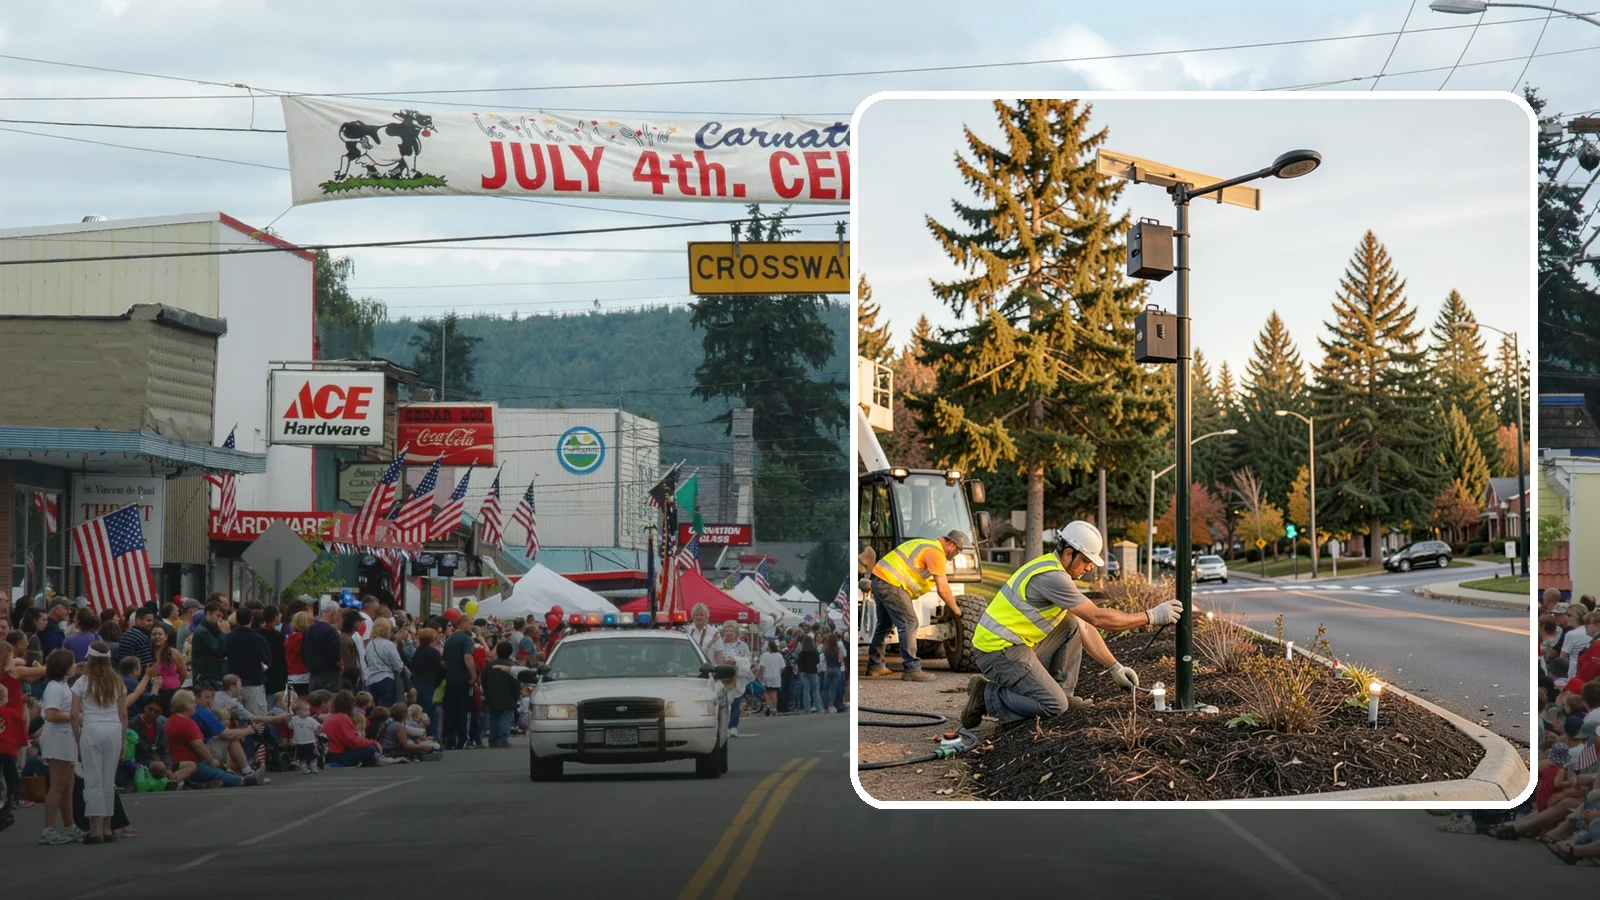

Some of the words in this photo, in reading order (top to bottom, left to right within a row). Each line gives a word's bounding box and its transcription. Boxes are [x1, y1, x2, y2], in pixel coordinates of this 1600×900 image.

[695, 122, 850, 150] Carnat
[481, 141, 605, 193] JULY
[632, 150, 746, 197] 4th.
[697, 254, 850, 280] CROSSWA
[283, 380, 374, 420] ACE
[406, 409, 452, 421] CEDAR
[461, 409, 485, 421] LOG
[283, 421, 371, 436] Hardware
[416, 428, 477, 446] Coca-Cola
[354, 467, 386, 479] Simpl
[83, 485, 93, 494] St.
[95, 485, 124, 495] Vincent
[126, 486, 135, 495] de
[138, 486, 155, 495] Paul
[81, 503, 153, 522] THT
[688, 527, 741, 535] CRNATION
[699, 535, 730, 543] GLASS
